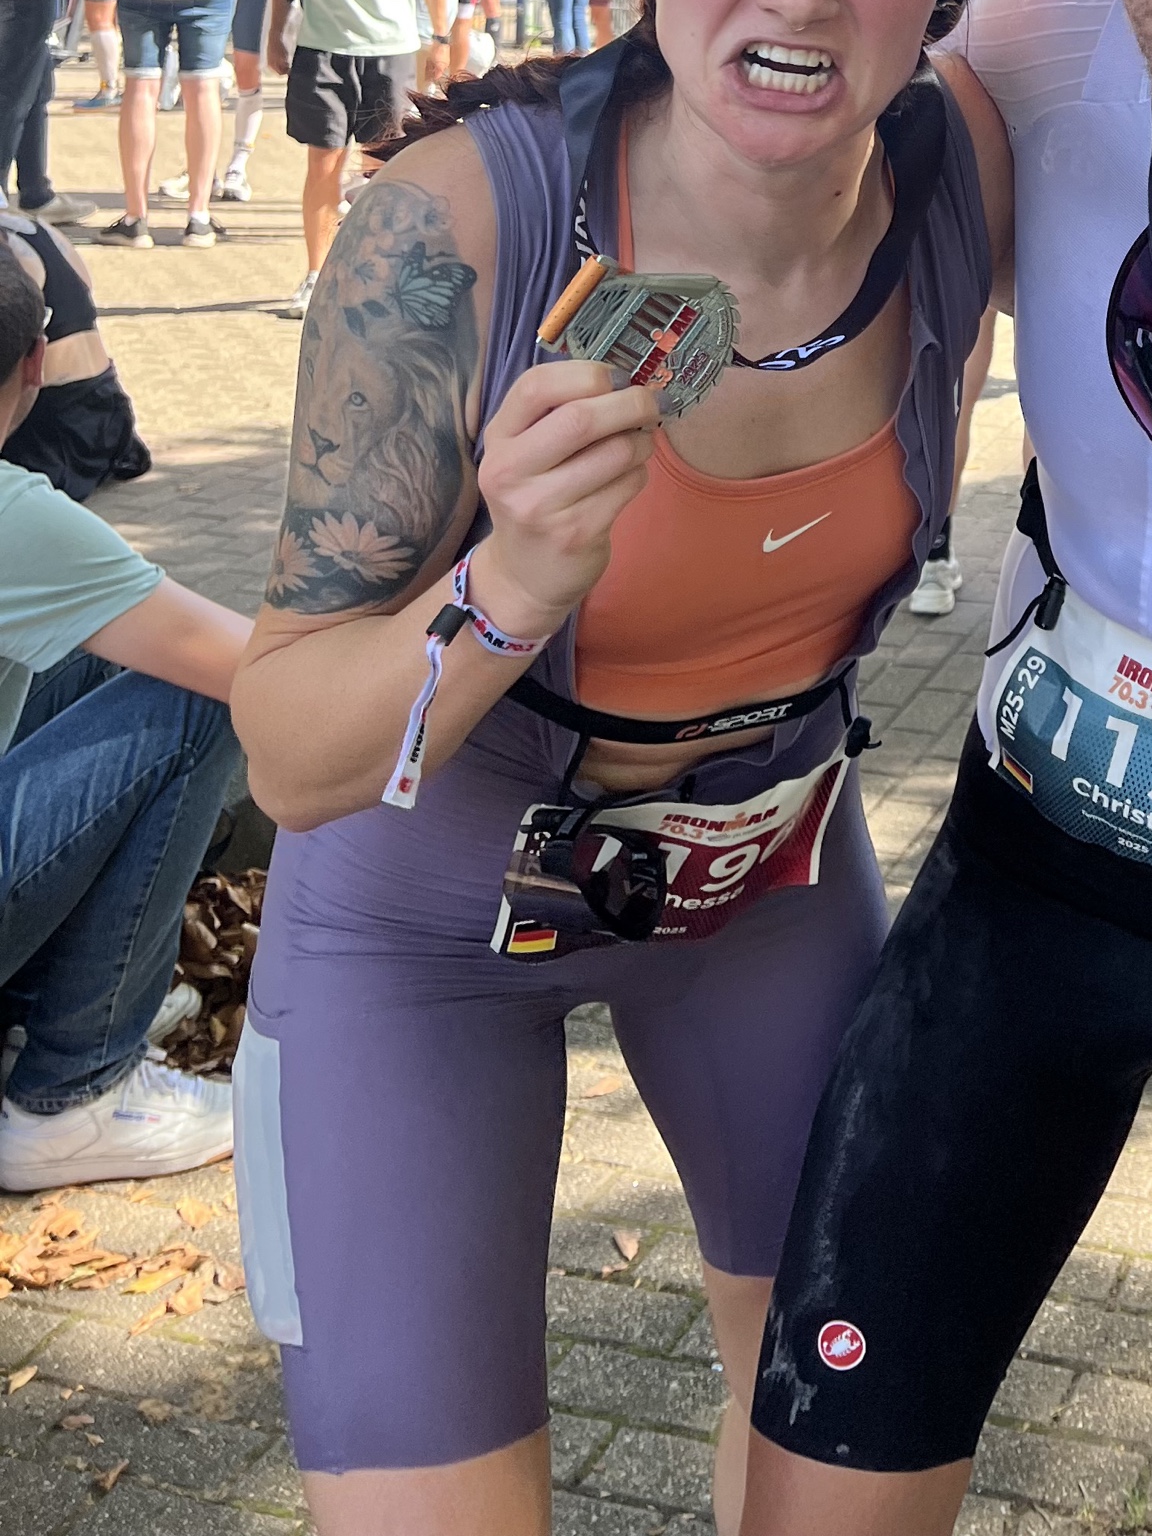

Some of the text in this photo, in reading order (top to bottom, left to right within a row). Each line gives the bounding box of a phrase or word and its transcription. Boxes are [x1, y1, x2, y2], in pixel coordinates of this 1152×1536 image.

[679, 350, 709, 385] 2025
[1000, 656, 1046, 741] M25-29
[1108, 674, 1149, 710] 70.3
[662, 805, 780, 832] IRONMAN
[1117, 836, 1149, 854] 2025
